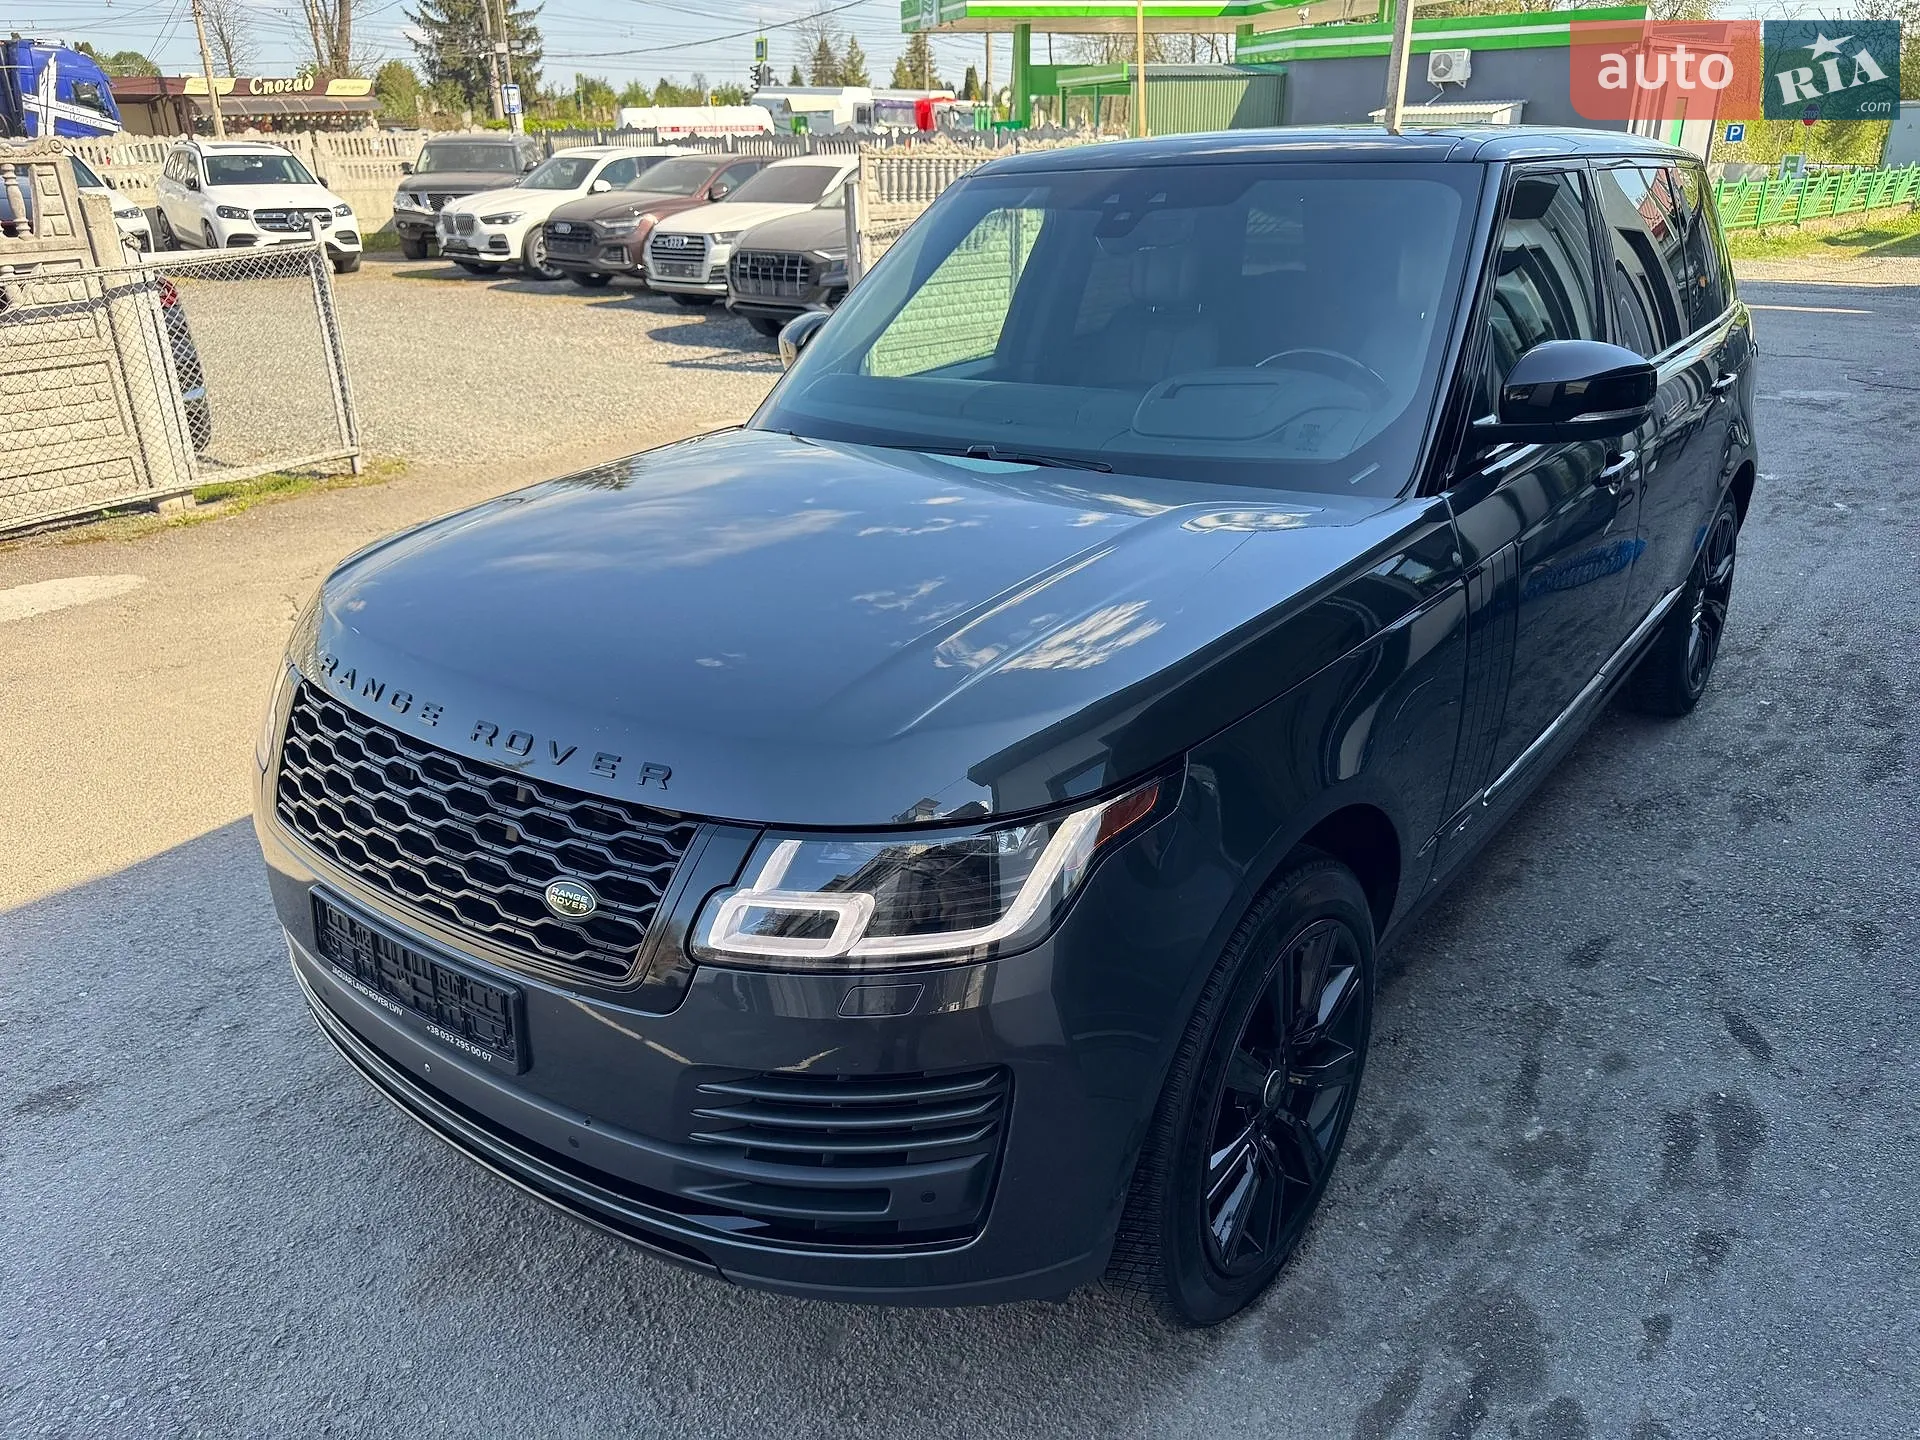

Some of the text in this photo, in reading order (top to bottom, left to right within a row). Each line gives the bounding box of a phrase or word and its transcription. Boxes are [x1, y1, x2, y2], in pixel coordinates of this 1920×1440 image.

[249, 74, 315, 96] Спогад
[1803, 110, 1819, 119] STOP
[1730, 126, 1741, 140] P
[320, 653, 672, 790] RANGE ROVER
[550, 895, 588, 911] ROVER
[551, 887, 589, 904] RANGE
[332, 966, 403, 1016] JAGUAR LAND ROVER LVIV
[426, 1025, 492, 1062] +38 032 295 00 07
